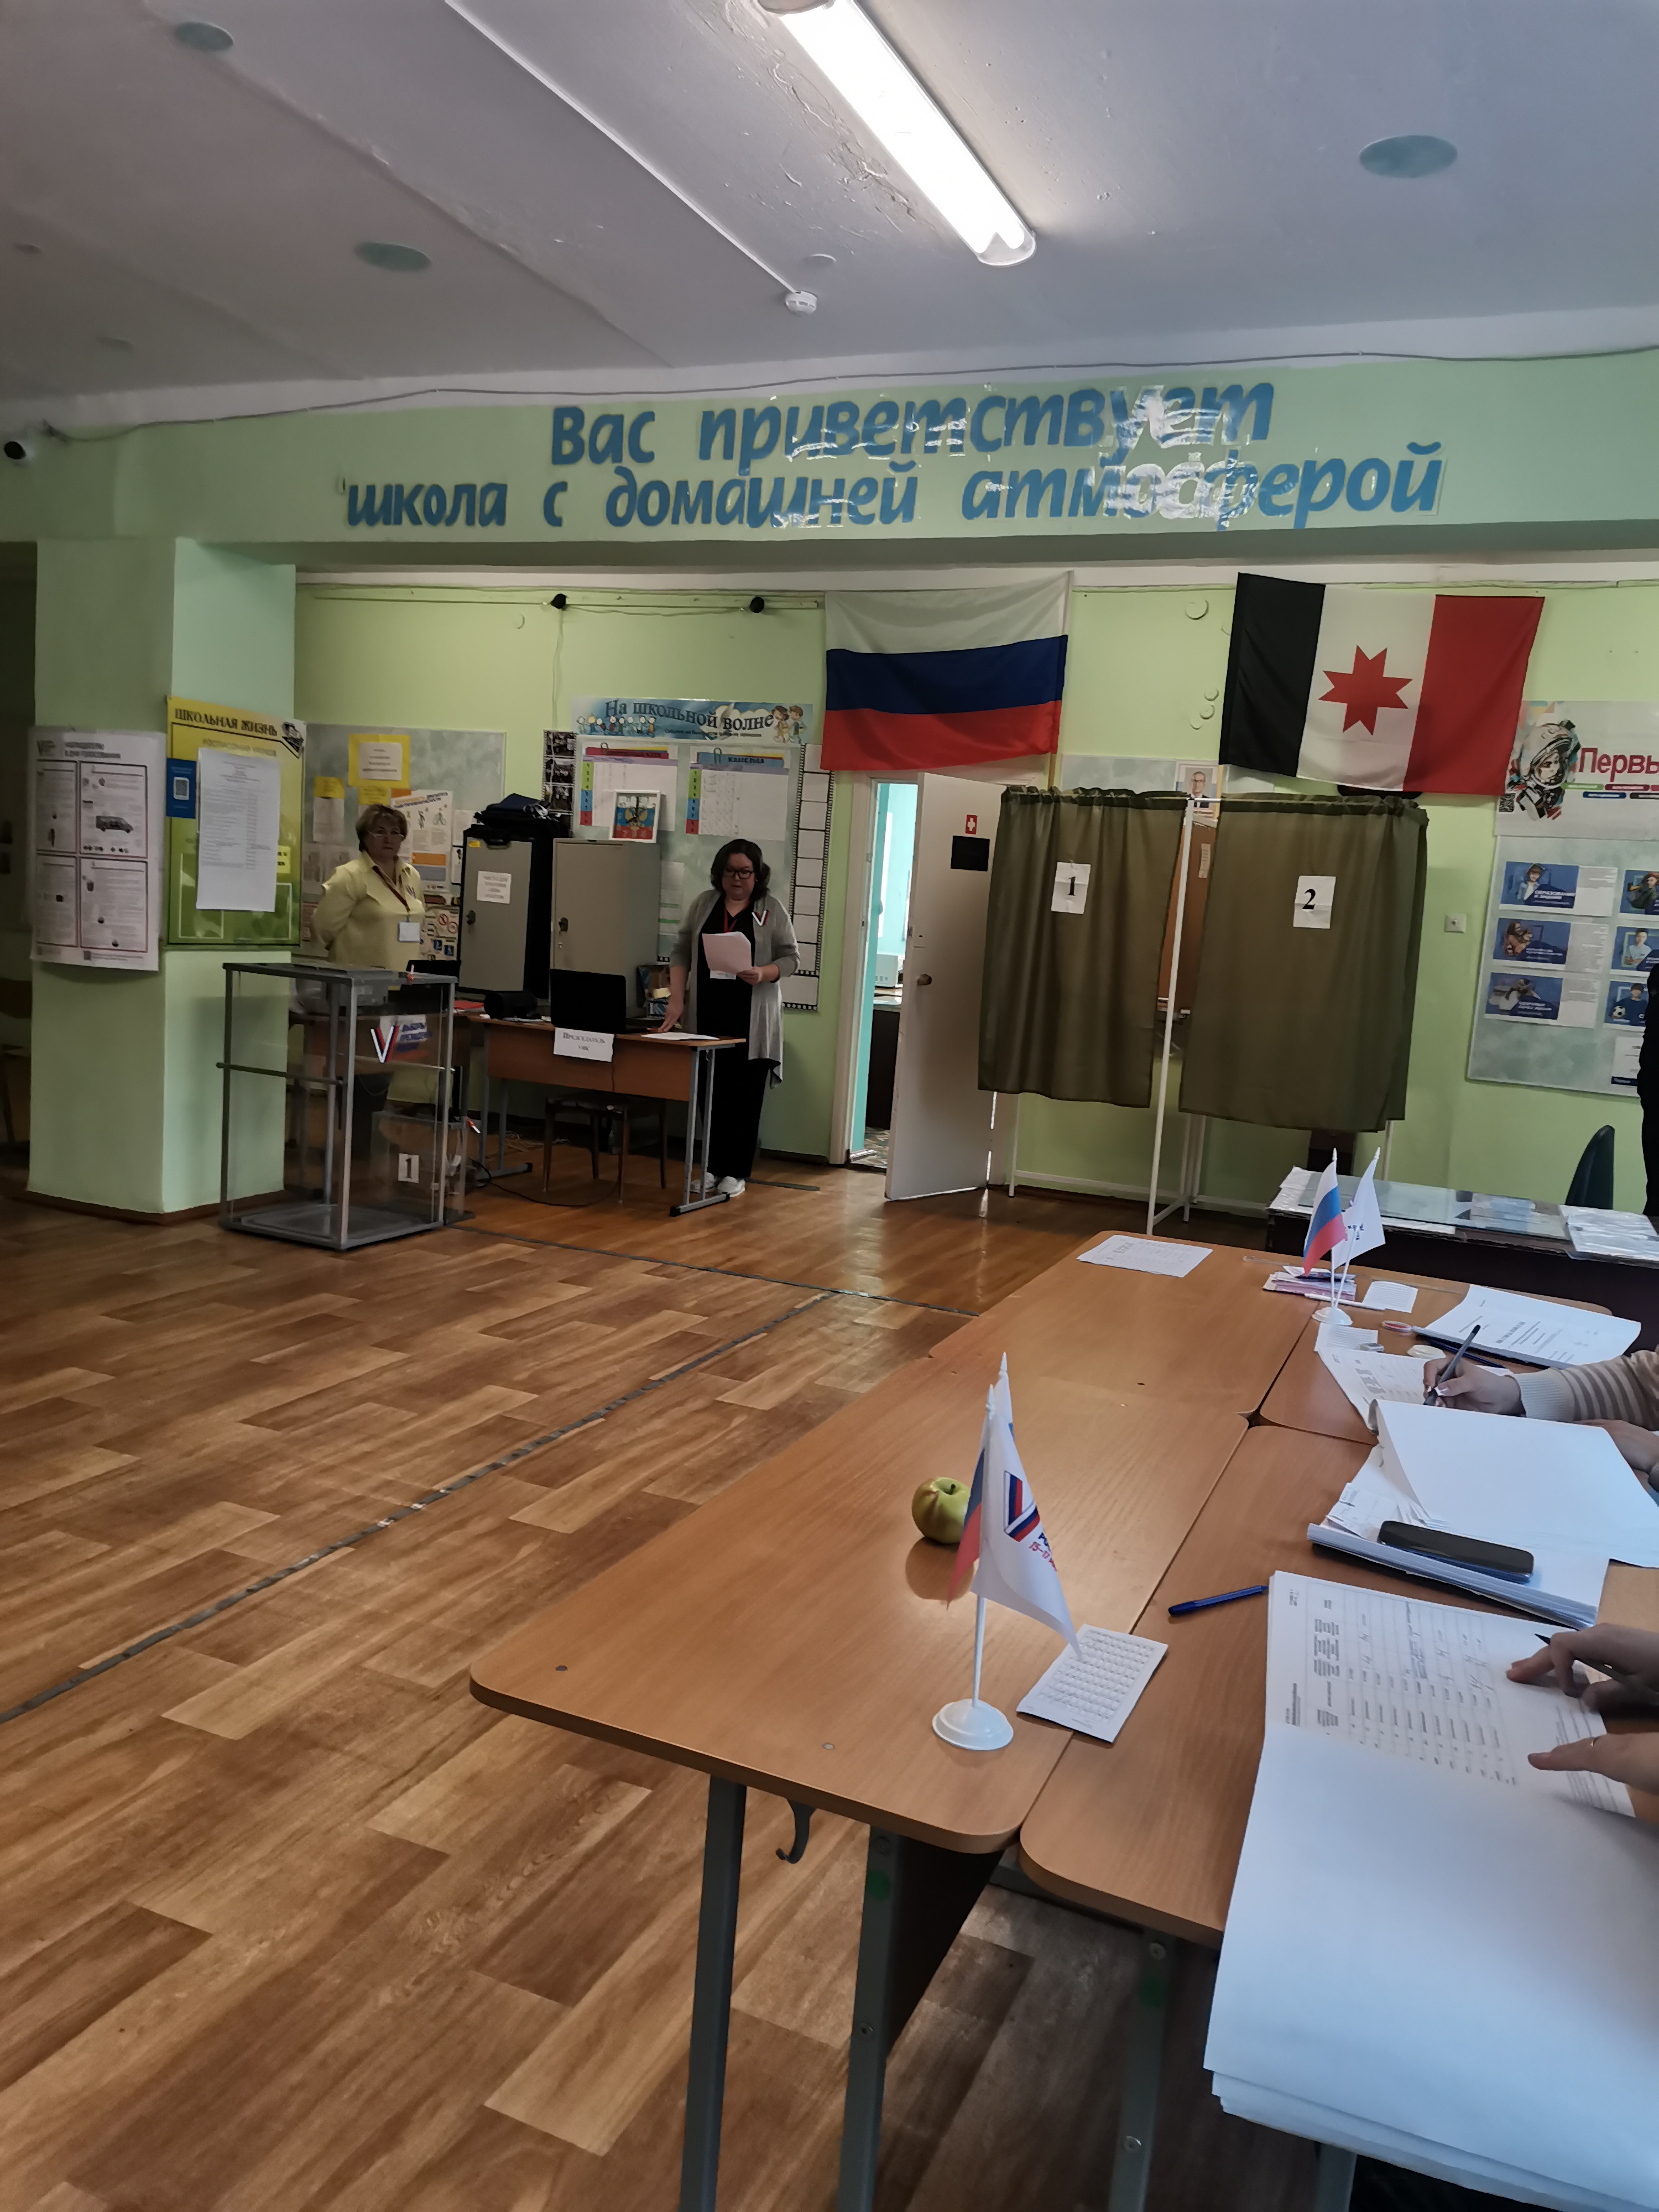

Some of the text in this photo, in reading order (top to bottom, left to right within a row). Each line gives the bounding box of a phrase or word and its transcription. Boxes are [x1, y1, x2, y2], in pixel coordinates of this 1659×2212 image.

[553, 405, 655, 465] Вас
[347, 442, 1442, 531] школа с домашней атмосферой
[175, 708, 278, 736] ШКОЛЬНАЯ ЖИЗНЬ
[605, 699, 774, 731] На школьной волне
[1067, 876, 1076, 896] 1
[1302, 889, 1316, 910] 2
[405, 1158, 413, 1179] 1
